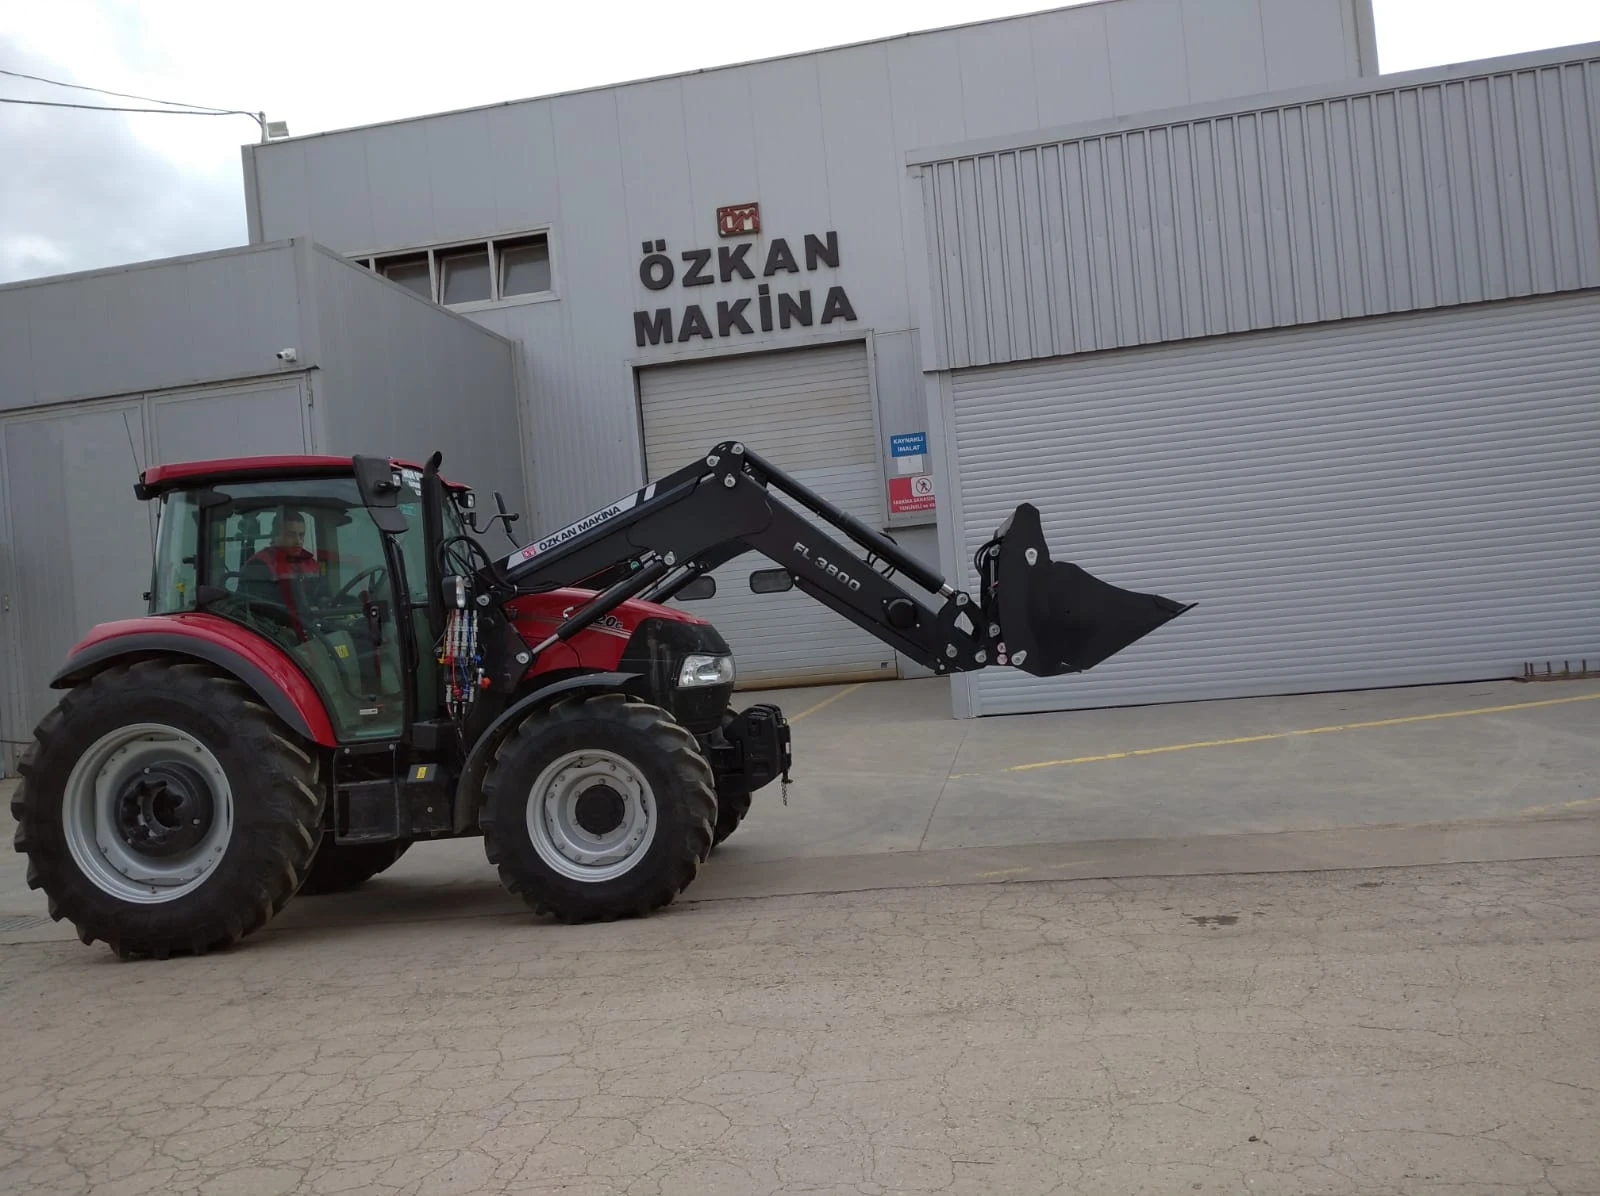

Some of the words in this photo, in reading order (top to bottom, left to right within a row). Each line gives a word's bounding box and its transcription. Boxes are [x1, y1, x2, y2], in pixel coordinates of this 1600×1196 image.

[639, 231, 840, 291] ÖZKAN
[633, 284, 858, 347] MAKİNA
[578, 506, 621, 532] MAKİNA
[793, 541, 810, 560] FL
[814, 557, 861, 591] 3800
